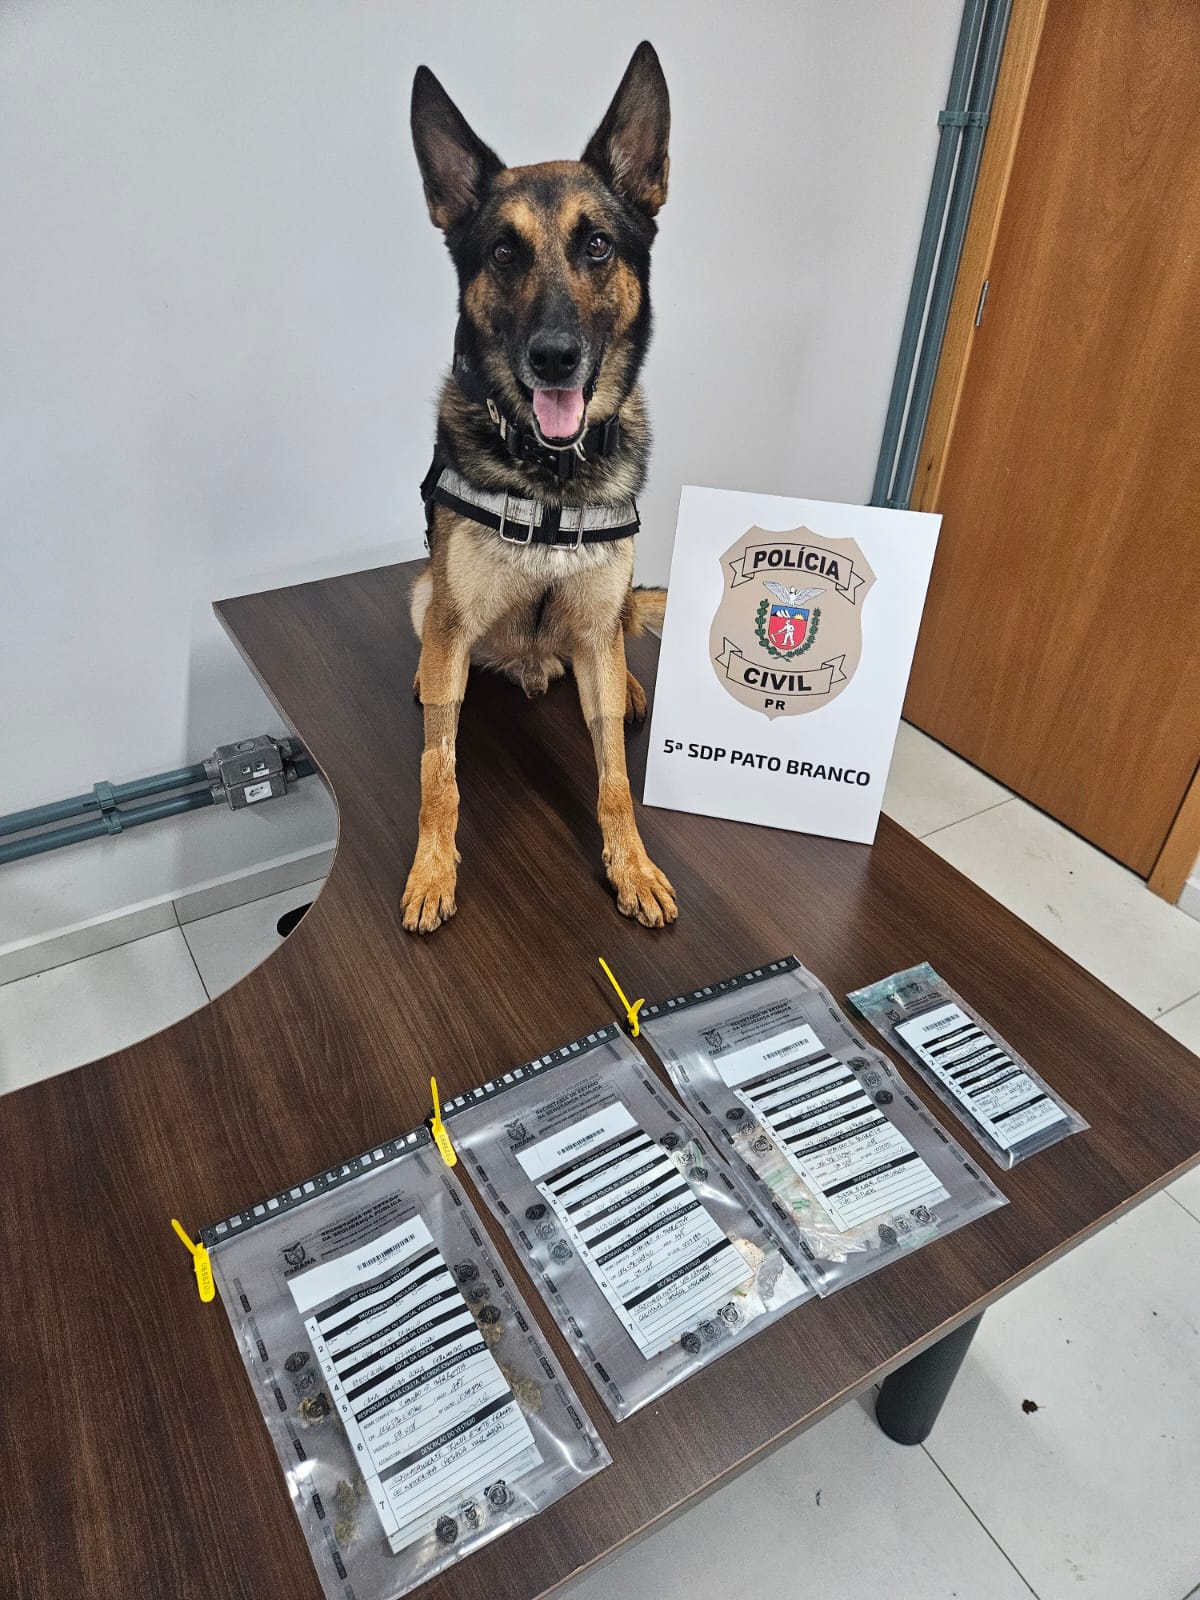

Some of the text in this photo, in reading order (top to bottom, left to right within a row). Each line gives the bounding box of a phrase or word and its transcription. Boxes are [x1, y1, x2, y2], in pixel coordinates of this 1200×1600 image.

[753, 547, 840, 581] POLÍCIA
[743, 667, 812, 692] CIVIL
[765, 699, 785, 710] PR
[663, 739, 870, 786] 5ª SDP PATO BRANCO
